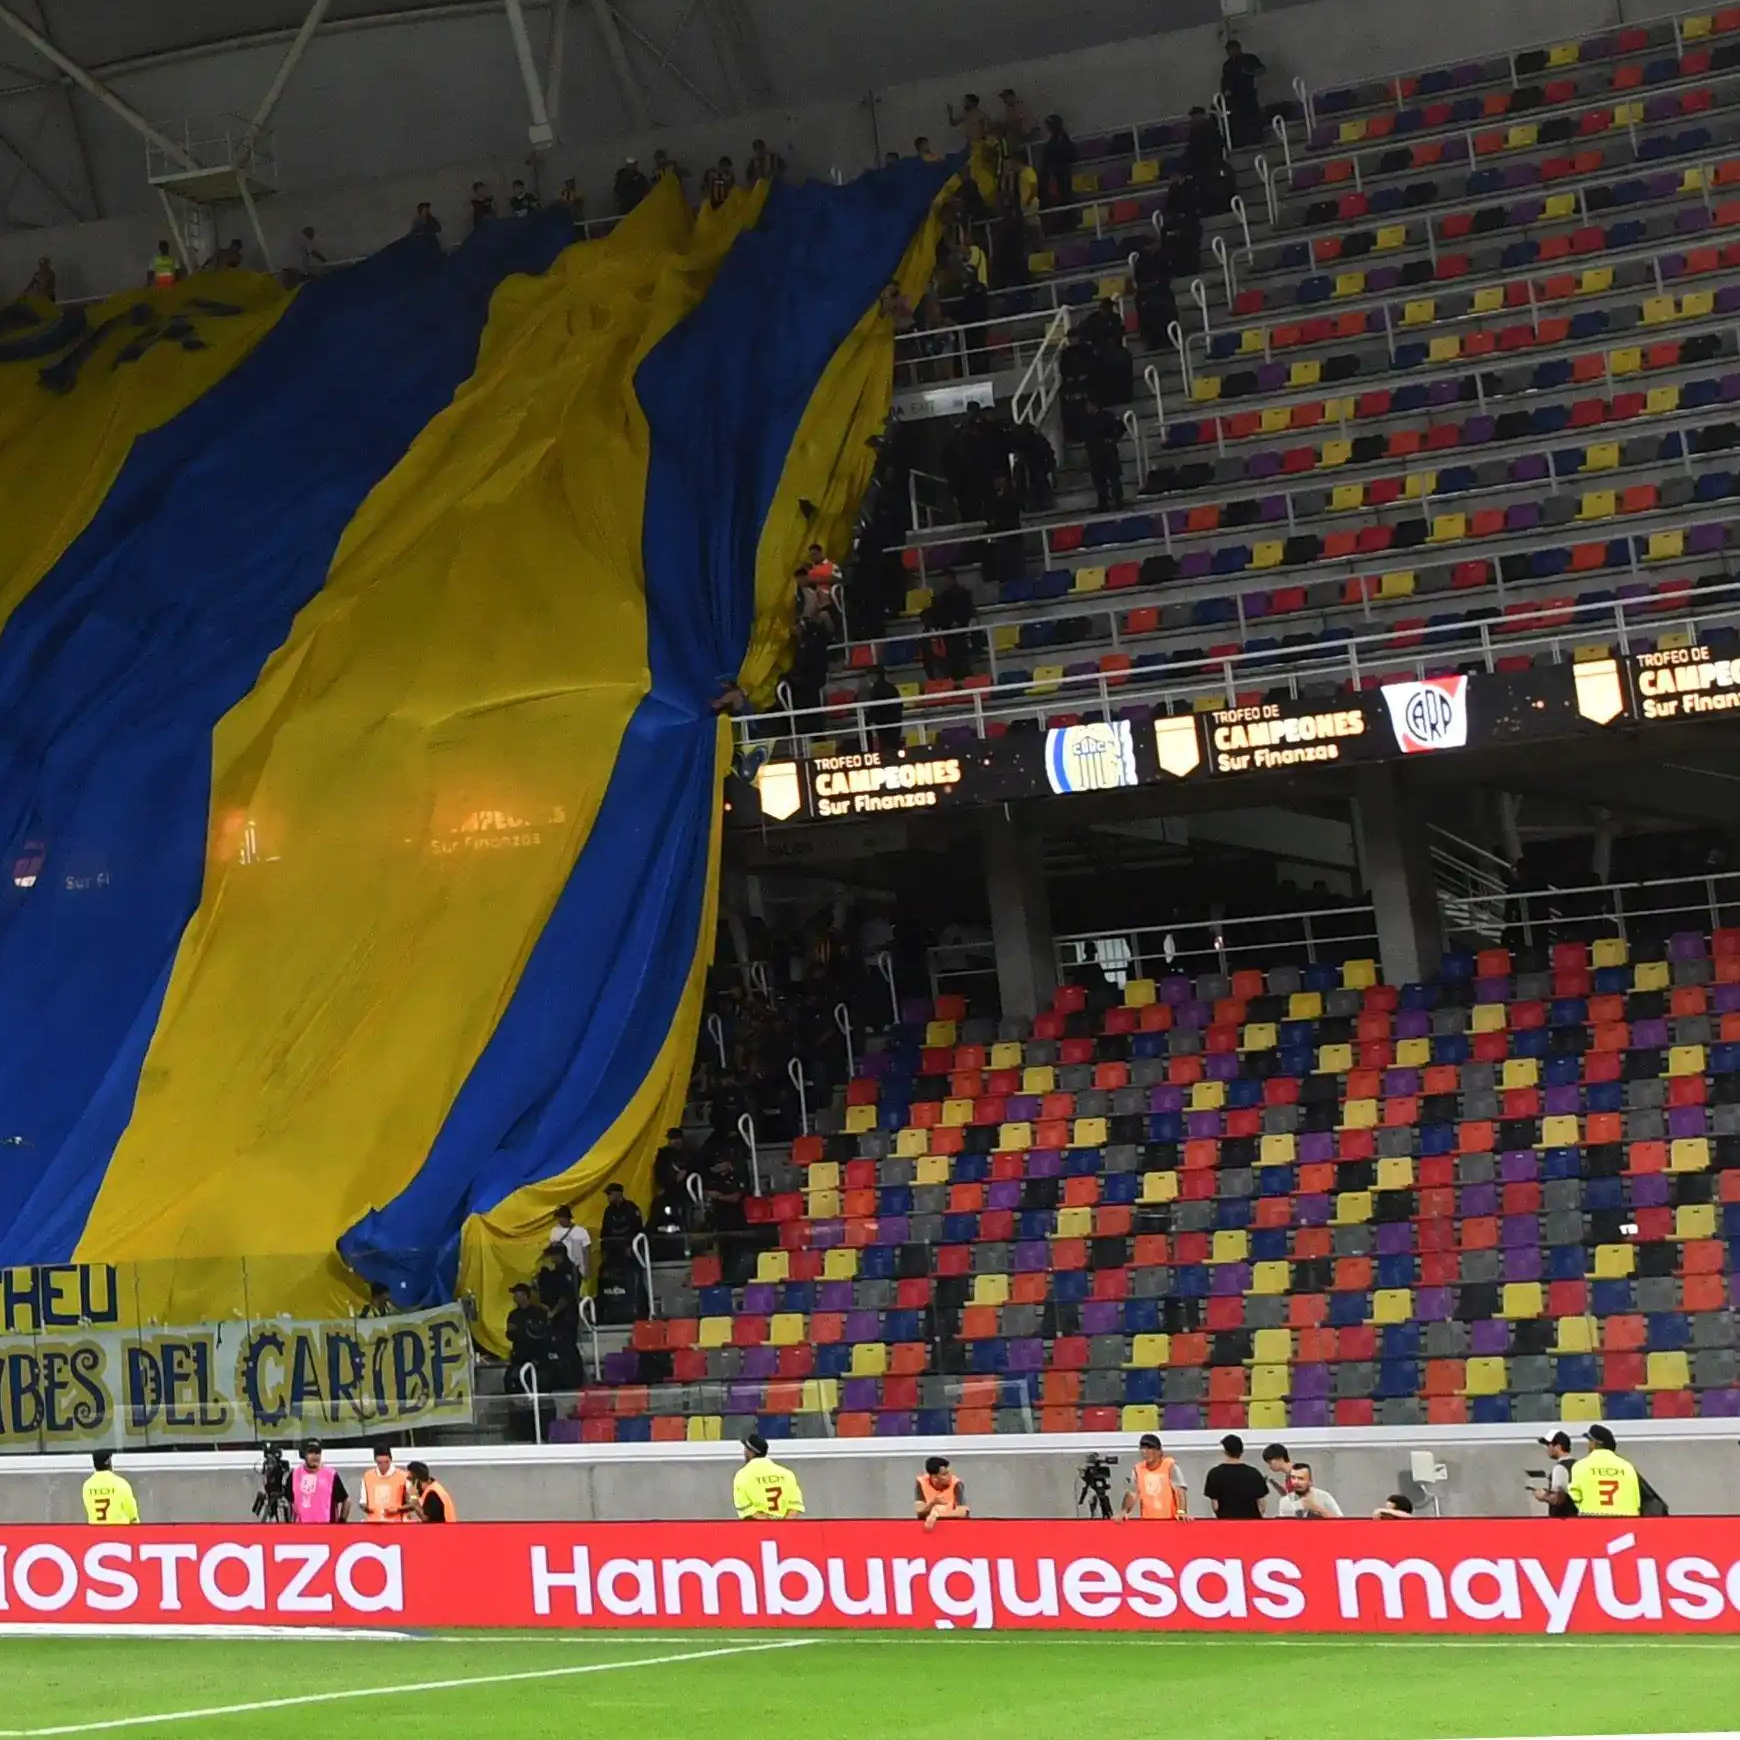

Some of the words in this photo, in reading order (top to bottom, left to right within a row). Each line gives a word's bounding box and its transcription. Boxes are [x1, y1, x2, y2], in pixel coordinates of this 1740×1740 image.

[1636, 648, 1690, 668] TROFEO
[1691, 646, 1710, 661] DE
[1212, 706, 1261, 725] TROFEO
[1262, 704, 1280, 719] DE
[1642, 698, 1678, 719] Sur
[1214, 710, 1365, 751] CAMPEONES
[814, 754, 862, 771] TROFEO
[863, 752, 881, 766] DE
[1217, 753, 1251, 772] Sur
[1254, 744, 1339, 768] Finanzas
[815, 759, 962, 797] CAMPEONES
[818, 798, 851, 817] Sur
[854, 791, 937, 813] Finanzas
[127, 1339, 226, 1428] DEL
[240, 1319, 466, 1427] CARIBE
[1589, 1466, 1625, 1477] TECH
[529, 1540, 1306, 1630] Hamburguesas
